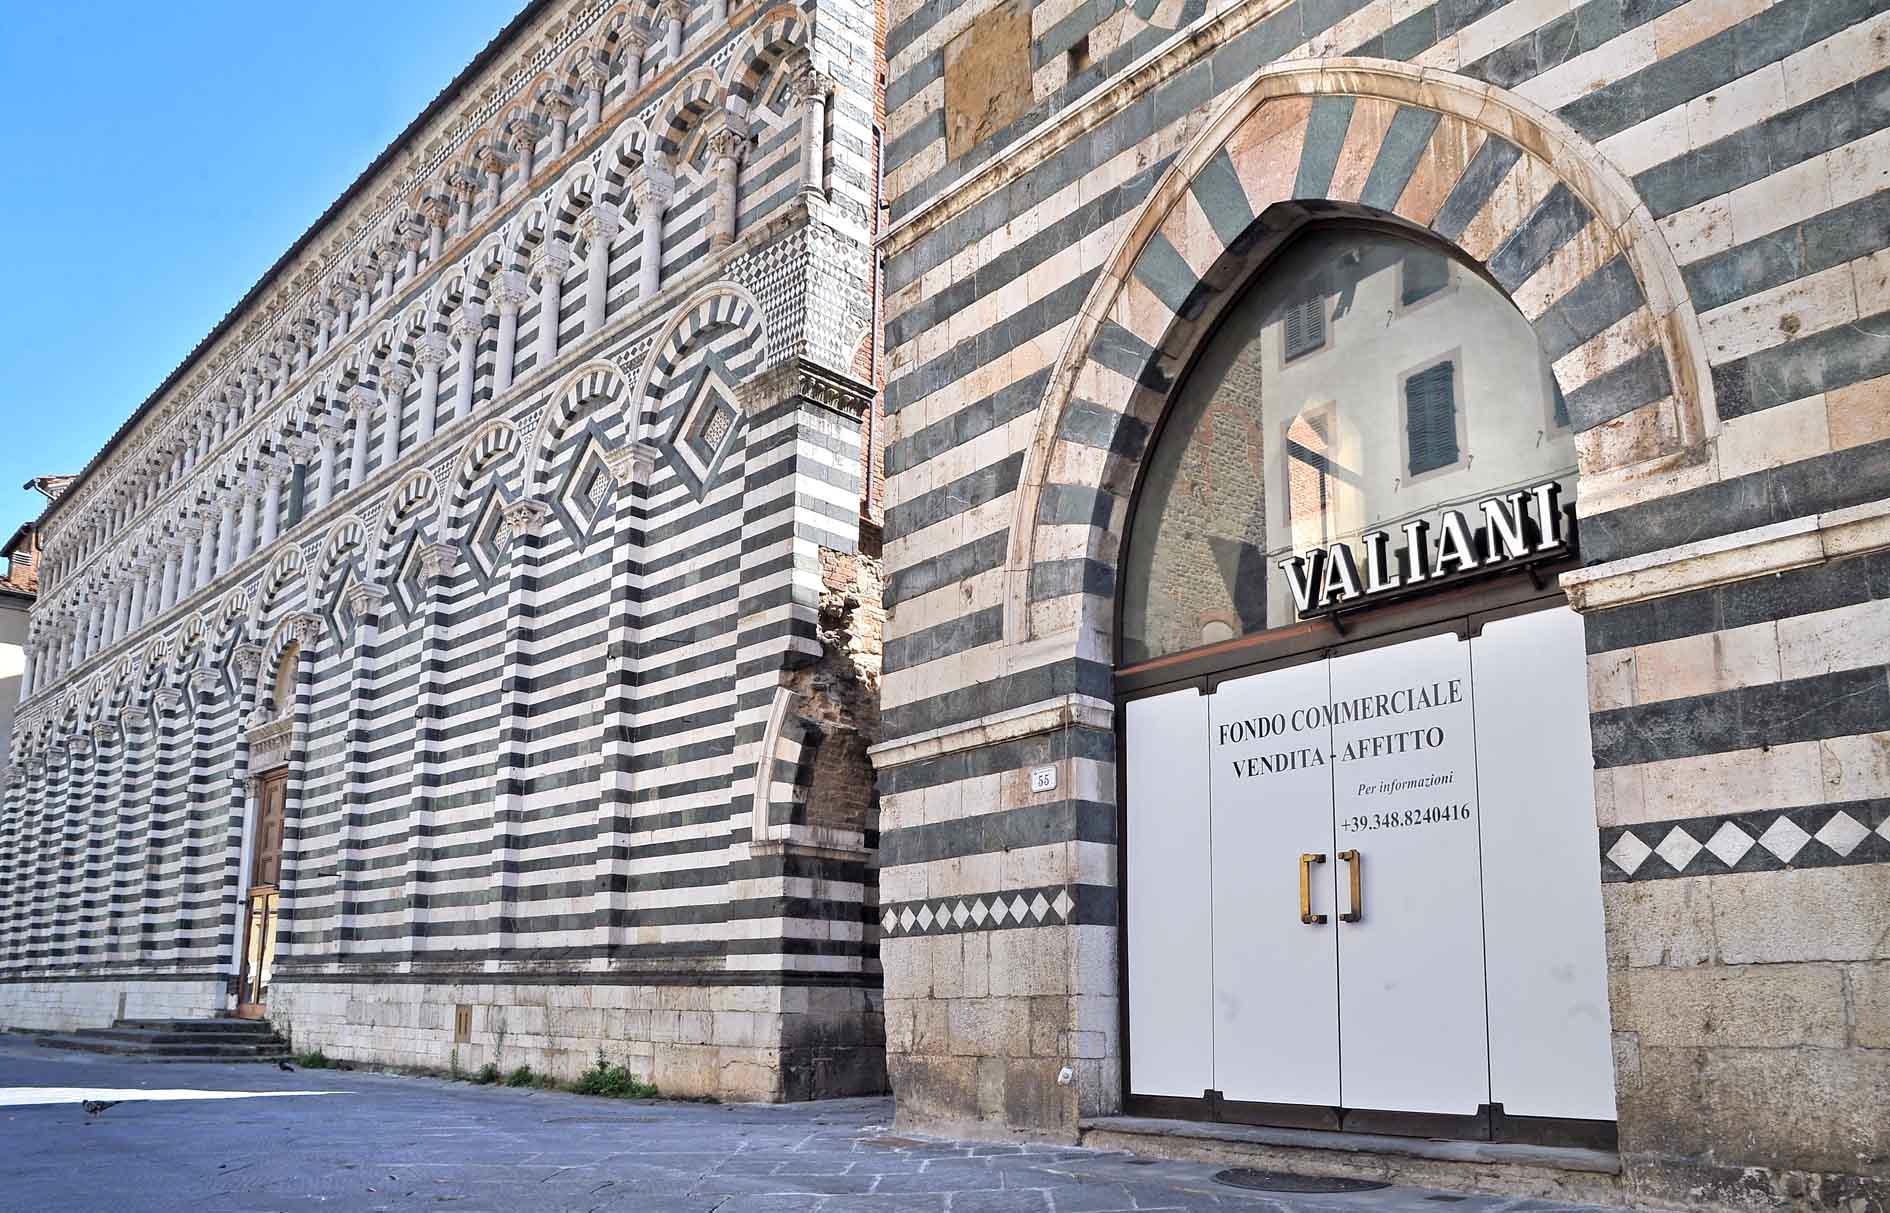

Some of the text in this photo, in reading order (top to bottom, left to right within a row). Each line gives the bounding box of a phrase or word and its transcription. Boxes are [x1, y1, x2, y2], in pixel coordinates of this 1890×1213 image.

[1279, 481, 1561, 613] VALIANI
[1219, 679, 1463, 745] FONDO COMMERCIALE
[1232, 748, 1325, 779] VENDITA
[1341, 726, 1444, 762] AFFITTO
[1038, 774, 1049, 787] 55
[1358, 771, 1454, 796] Per informazioni
[1341, 802, 1470, 832] +39.348.8240416
